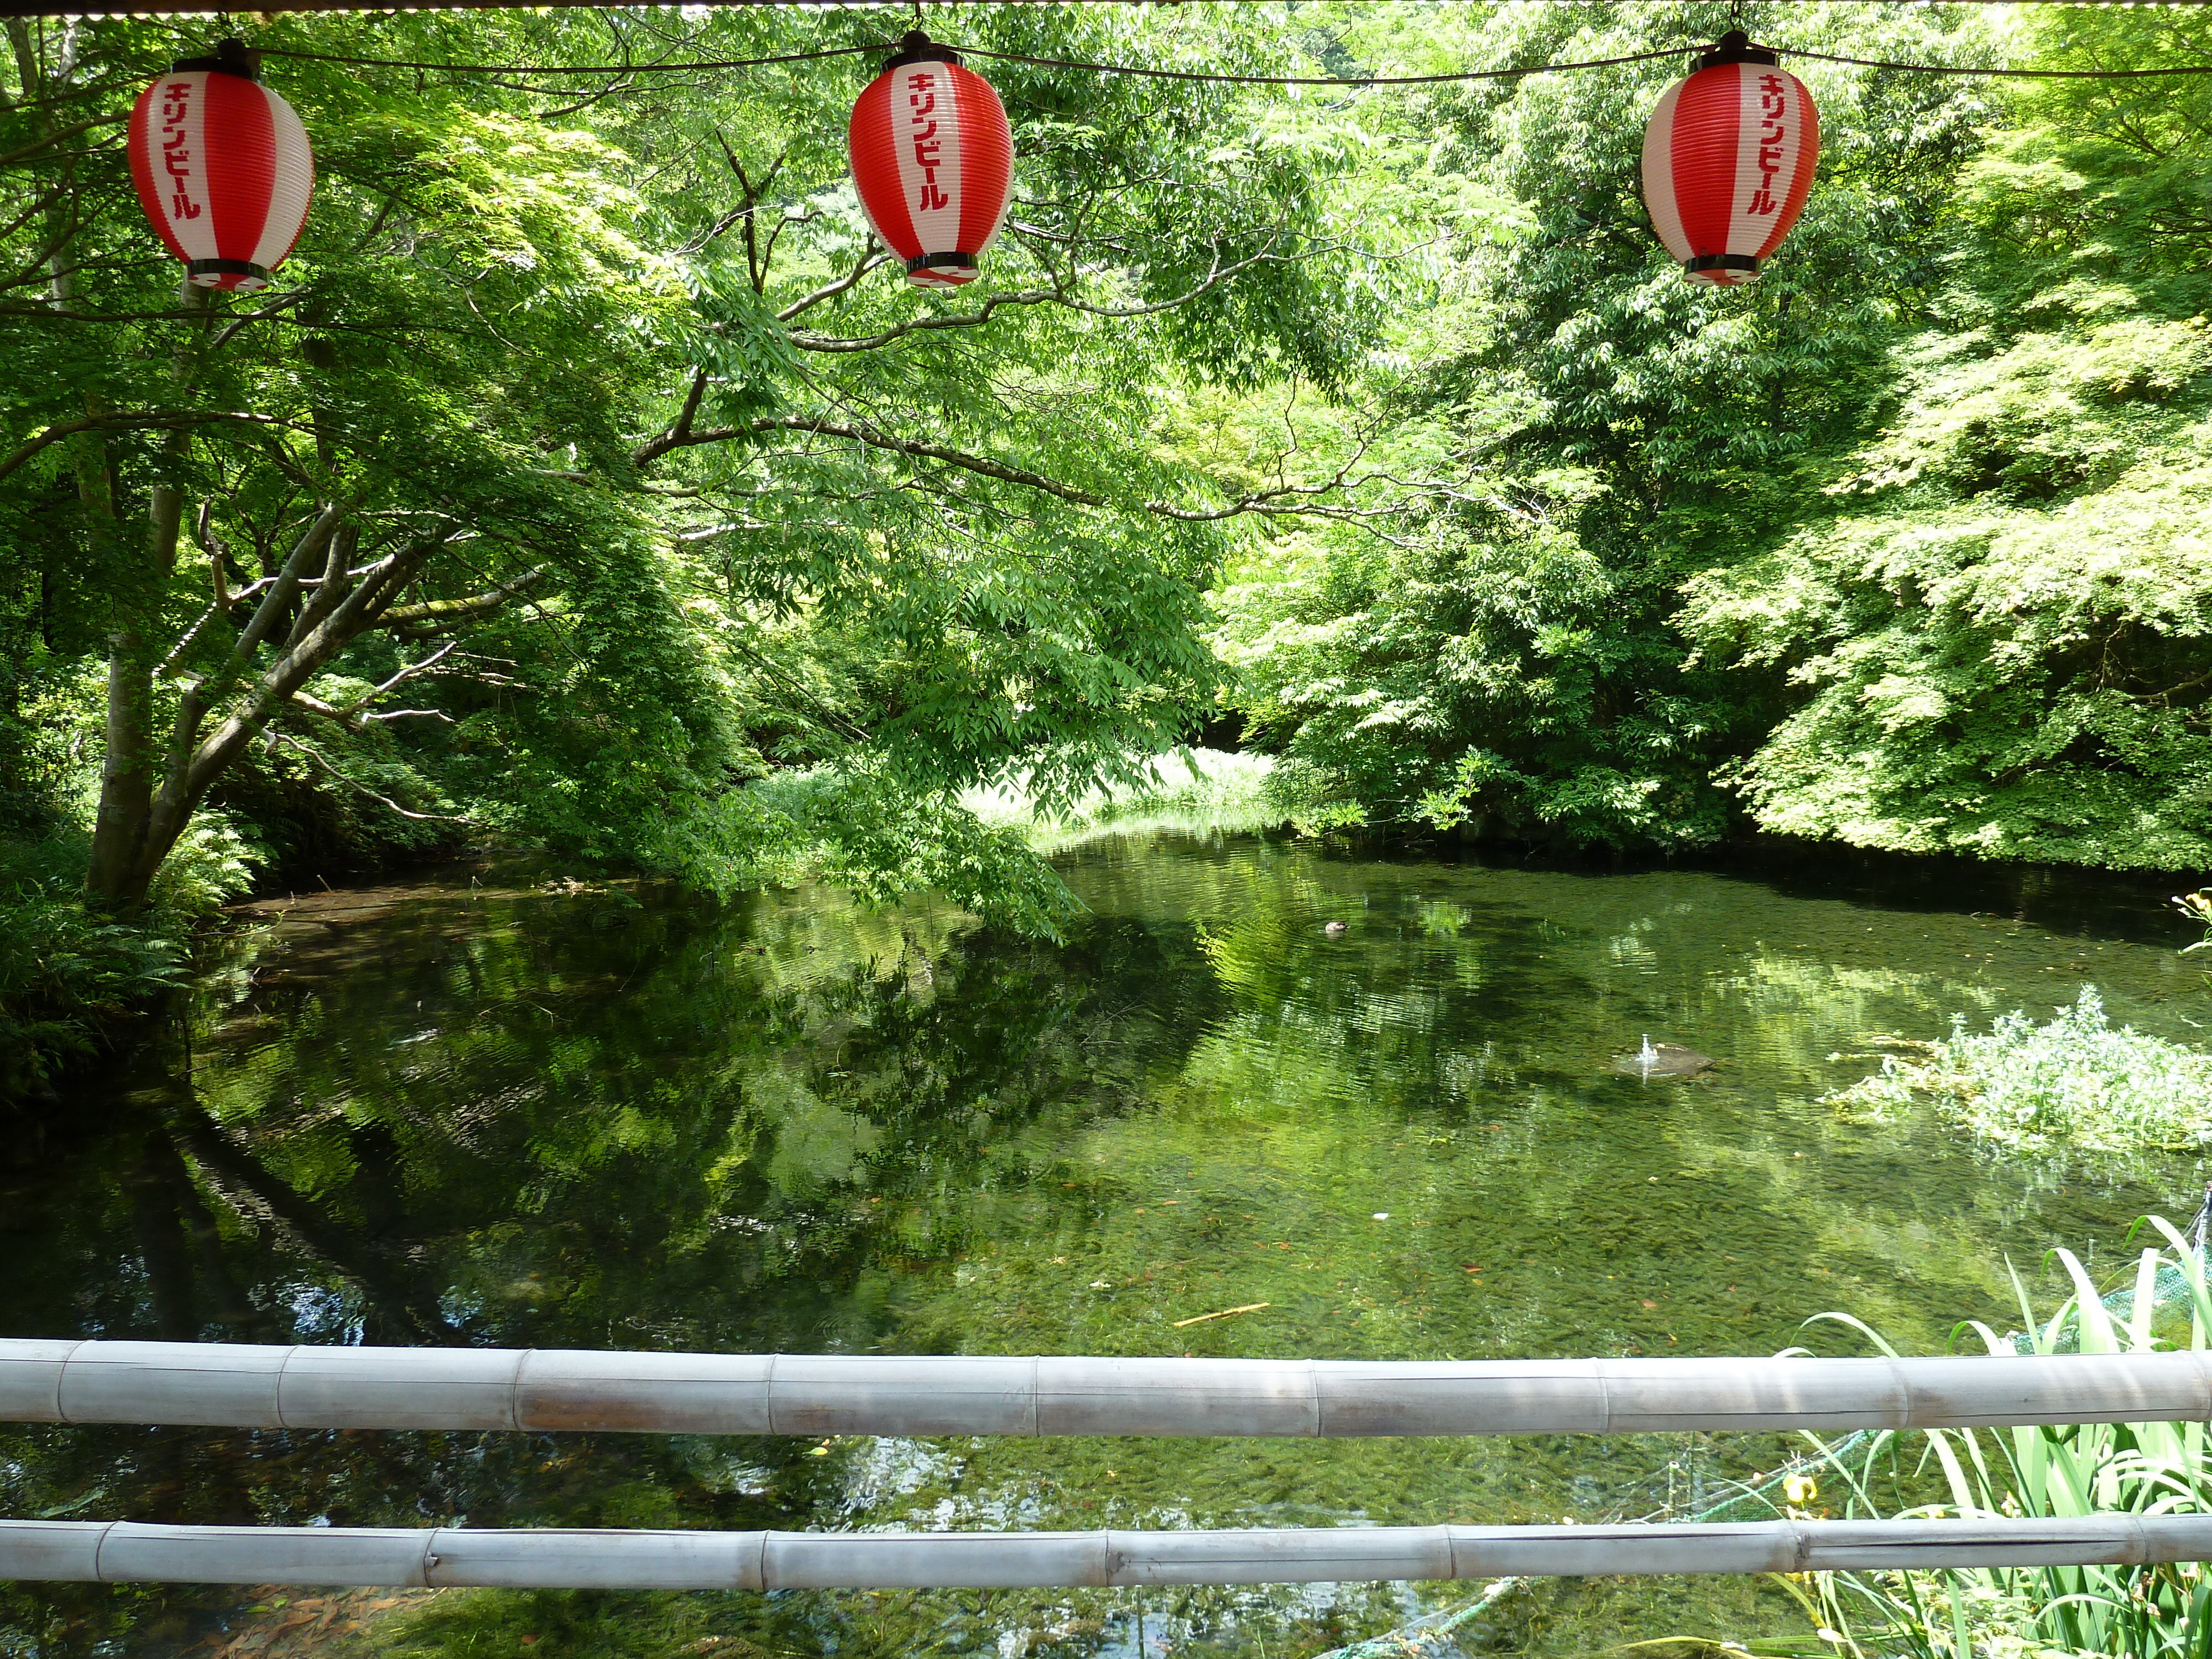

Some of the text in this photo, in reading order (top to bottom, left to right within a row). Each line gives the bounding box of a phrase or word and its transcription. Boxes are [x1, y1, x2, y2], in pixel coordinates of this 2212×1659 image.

[163, 84, 201, 220] キリンビール
[908, 74, 948, 211] キリンビール
[1747, 74, 1785, 215] キリンビール
